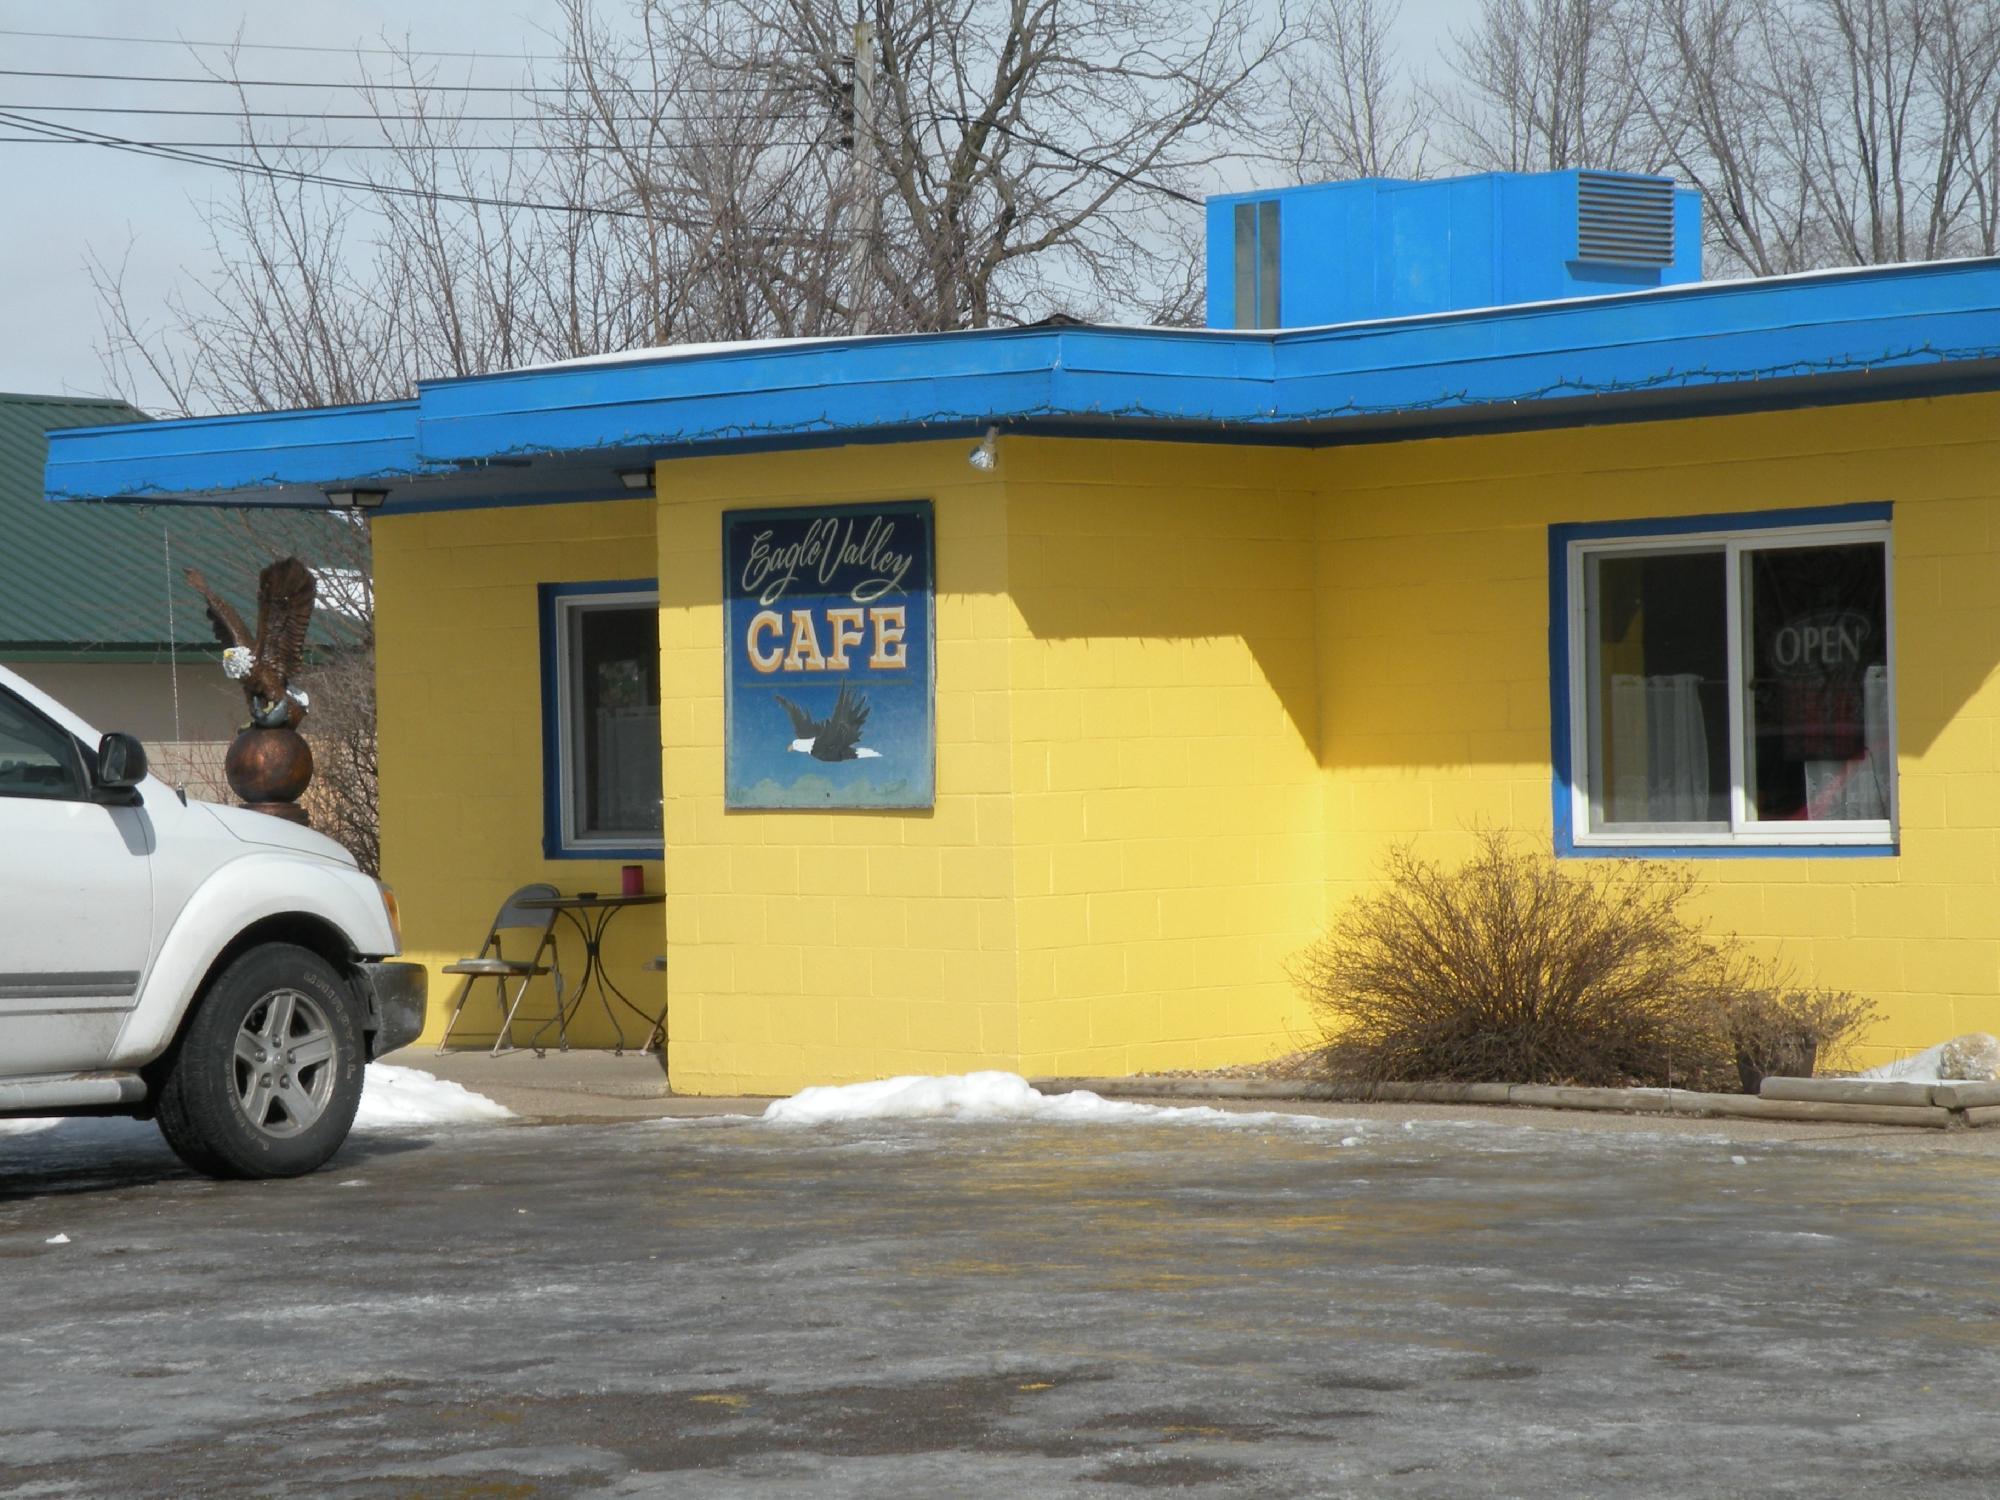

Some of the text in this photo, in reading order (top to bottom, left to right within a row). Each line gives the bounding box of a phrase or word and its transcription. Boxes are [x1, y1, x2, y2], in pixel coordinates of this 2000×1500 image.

[742, 516, 912, 605] Eagle Valley
[747, 606, 907, 673] CAFE
[1776, 625, 1860, 666] OPEN
